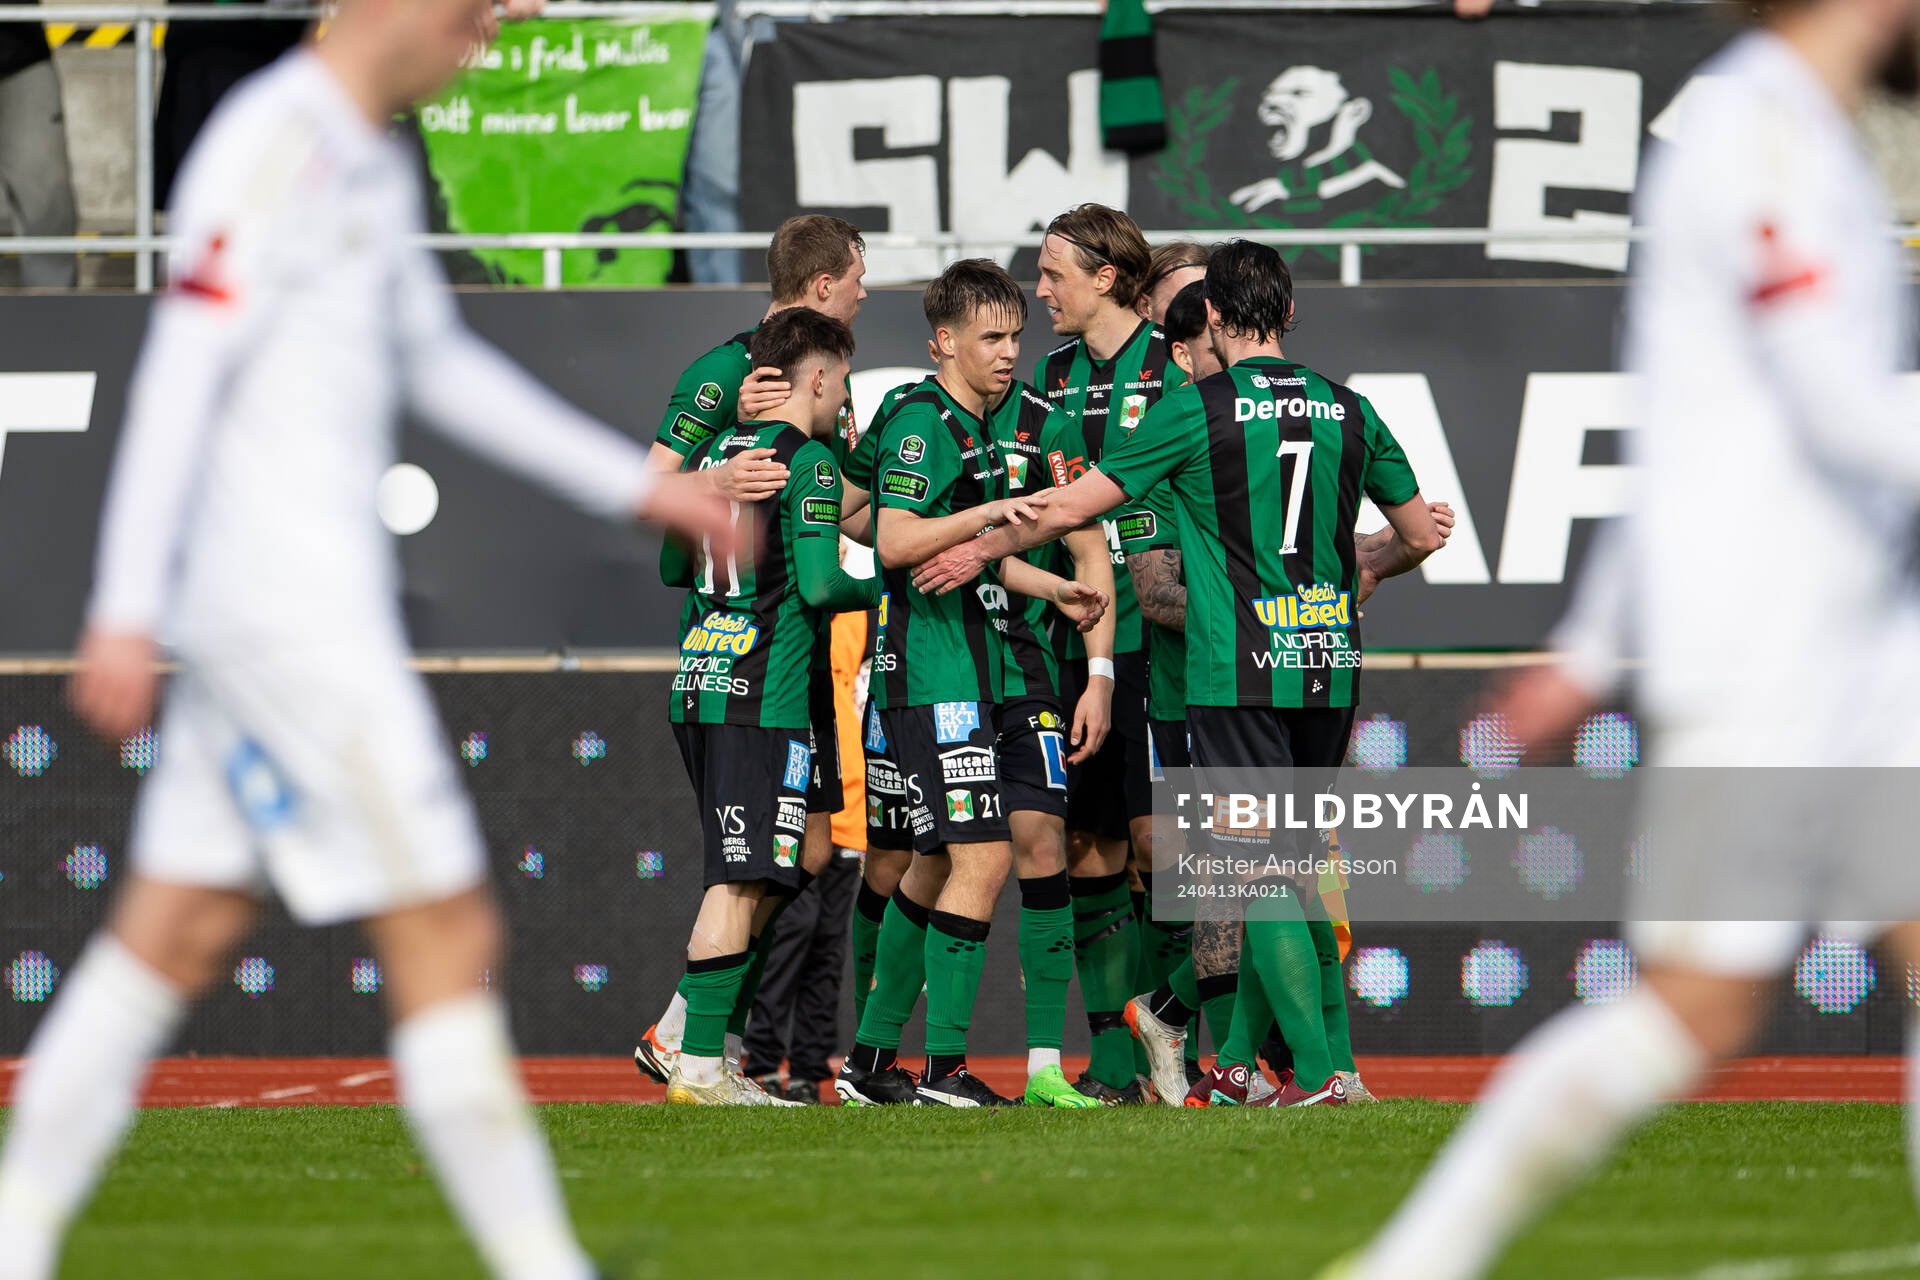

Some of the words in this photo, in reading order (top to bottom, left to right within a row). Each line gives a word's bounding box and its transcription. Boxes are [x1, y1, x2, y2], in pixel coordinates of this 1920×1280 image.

[1234, 397, 1346, 422] Derome
[677, 416, 716, 439] UNIBE
[885, 473, 925, 491] UNIBET
[1051, 453, 1068, 489] KVAN
[806, 502, 840, 515] UNIBE
[1275, 439, 1315, 555] 7
[1273, 631, 1349, 649] NORDIC
[1251, 650, 1362, 669] WELLNESS
[813, 764, 822, 789] 4
[887, 806, 910, 829] 17
[979, 793, 1001, 819] 21
